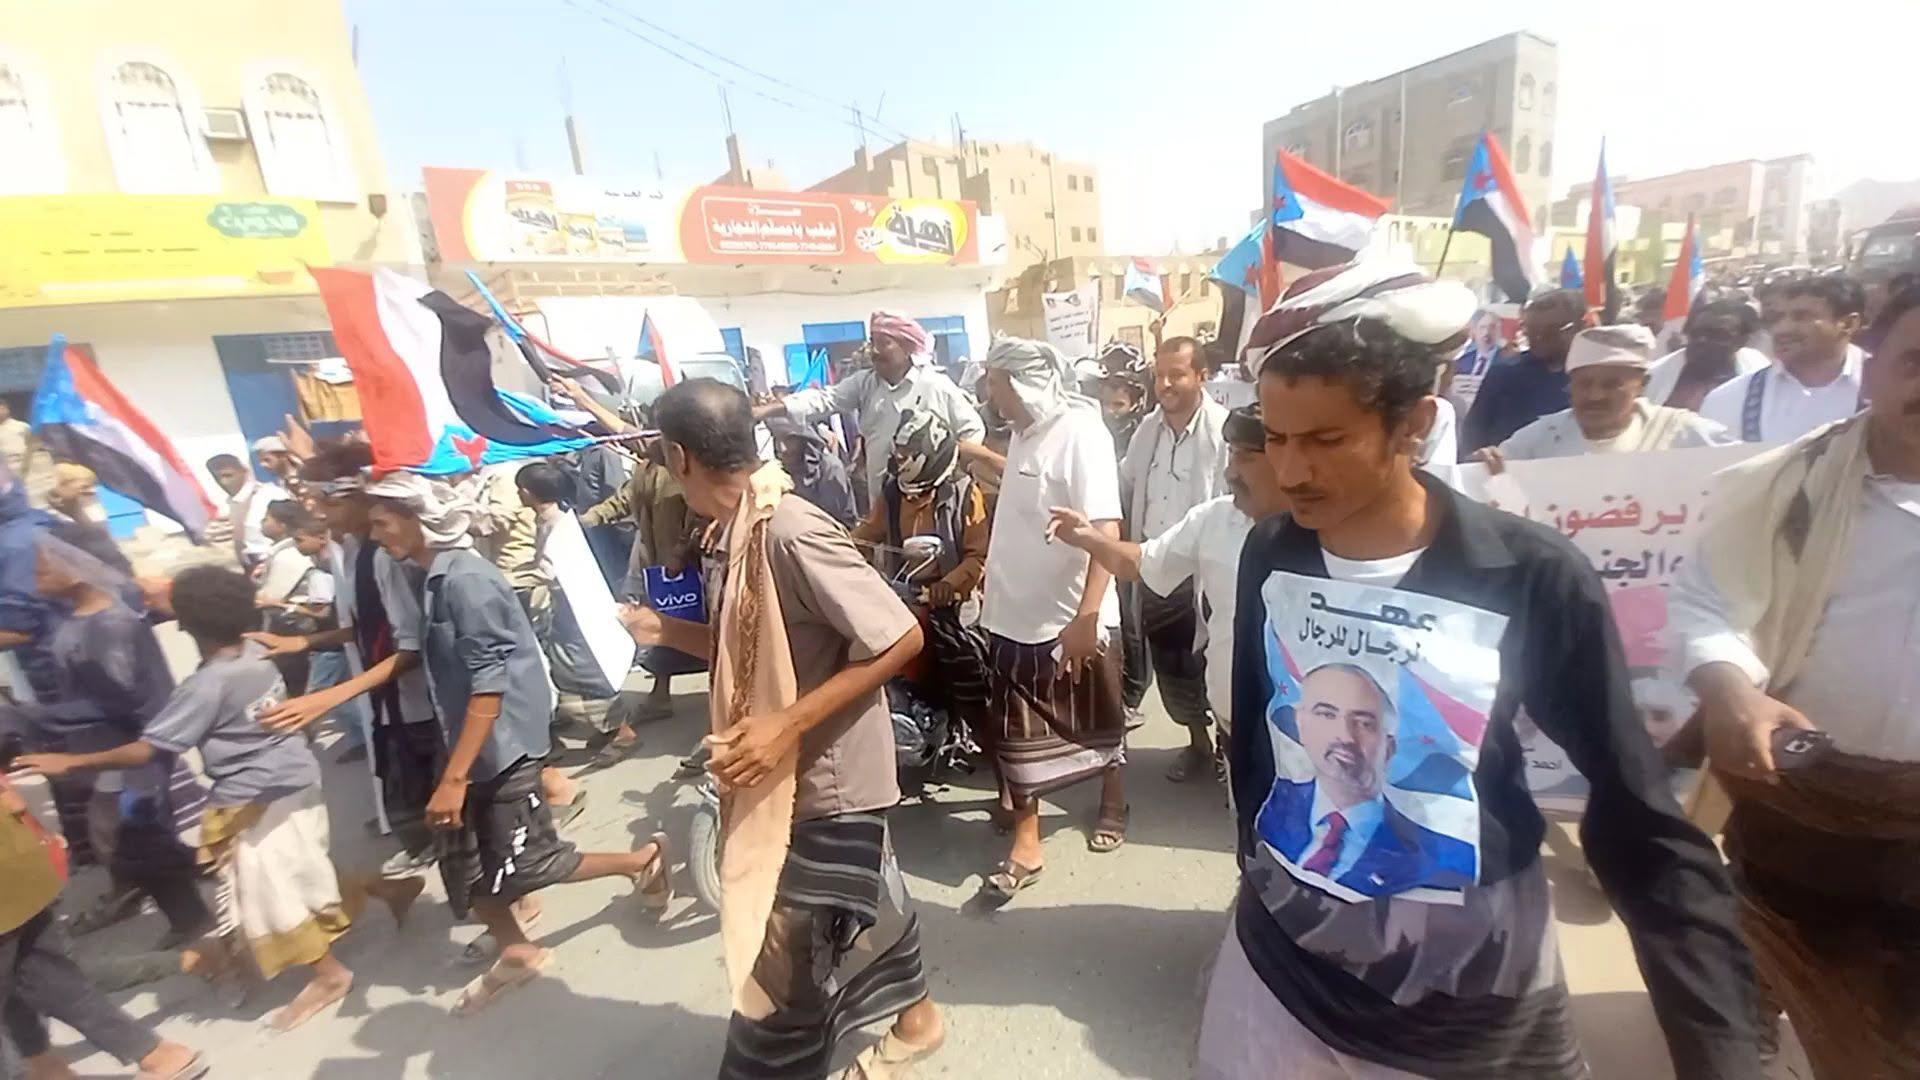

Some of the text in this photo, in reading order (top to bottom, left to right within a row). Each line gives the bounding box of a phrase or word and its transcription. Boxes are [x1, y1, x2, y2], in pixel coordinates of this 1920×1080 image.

[655, 592, 697, 606] vivo
[1309, 591, 1438, 632] عهد
[1299, 616, 1427, 665] لرجال للرجال
